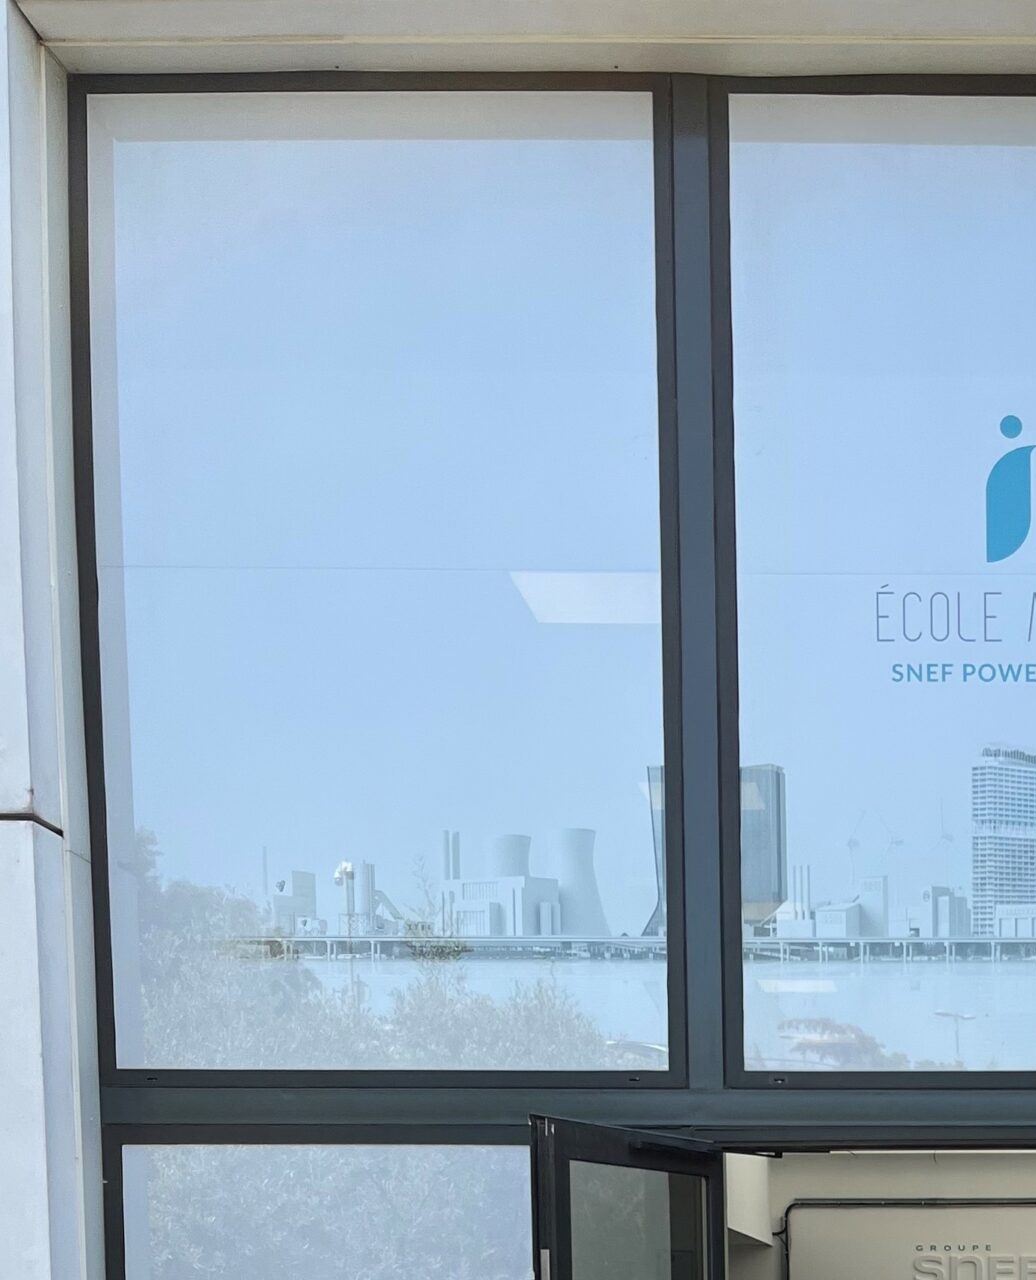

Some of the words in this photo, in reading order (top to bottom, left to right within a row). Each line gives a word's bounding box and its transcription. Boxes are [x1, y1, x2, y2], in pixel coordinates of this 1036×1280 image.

[876, 584, 1003, 642] ÉCOLE
[891, 663, 953, 683] SNEF
[915, 1244, 992, 1252] GROUPE
